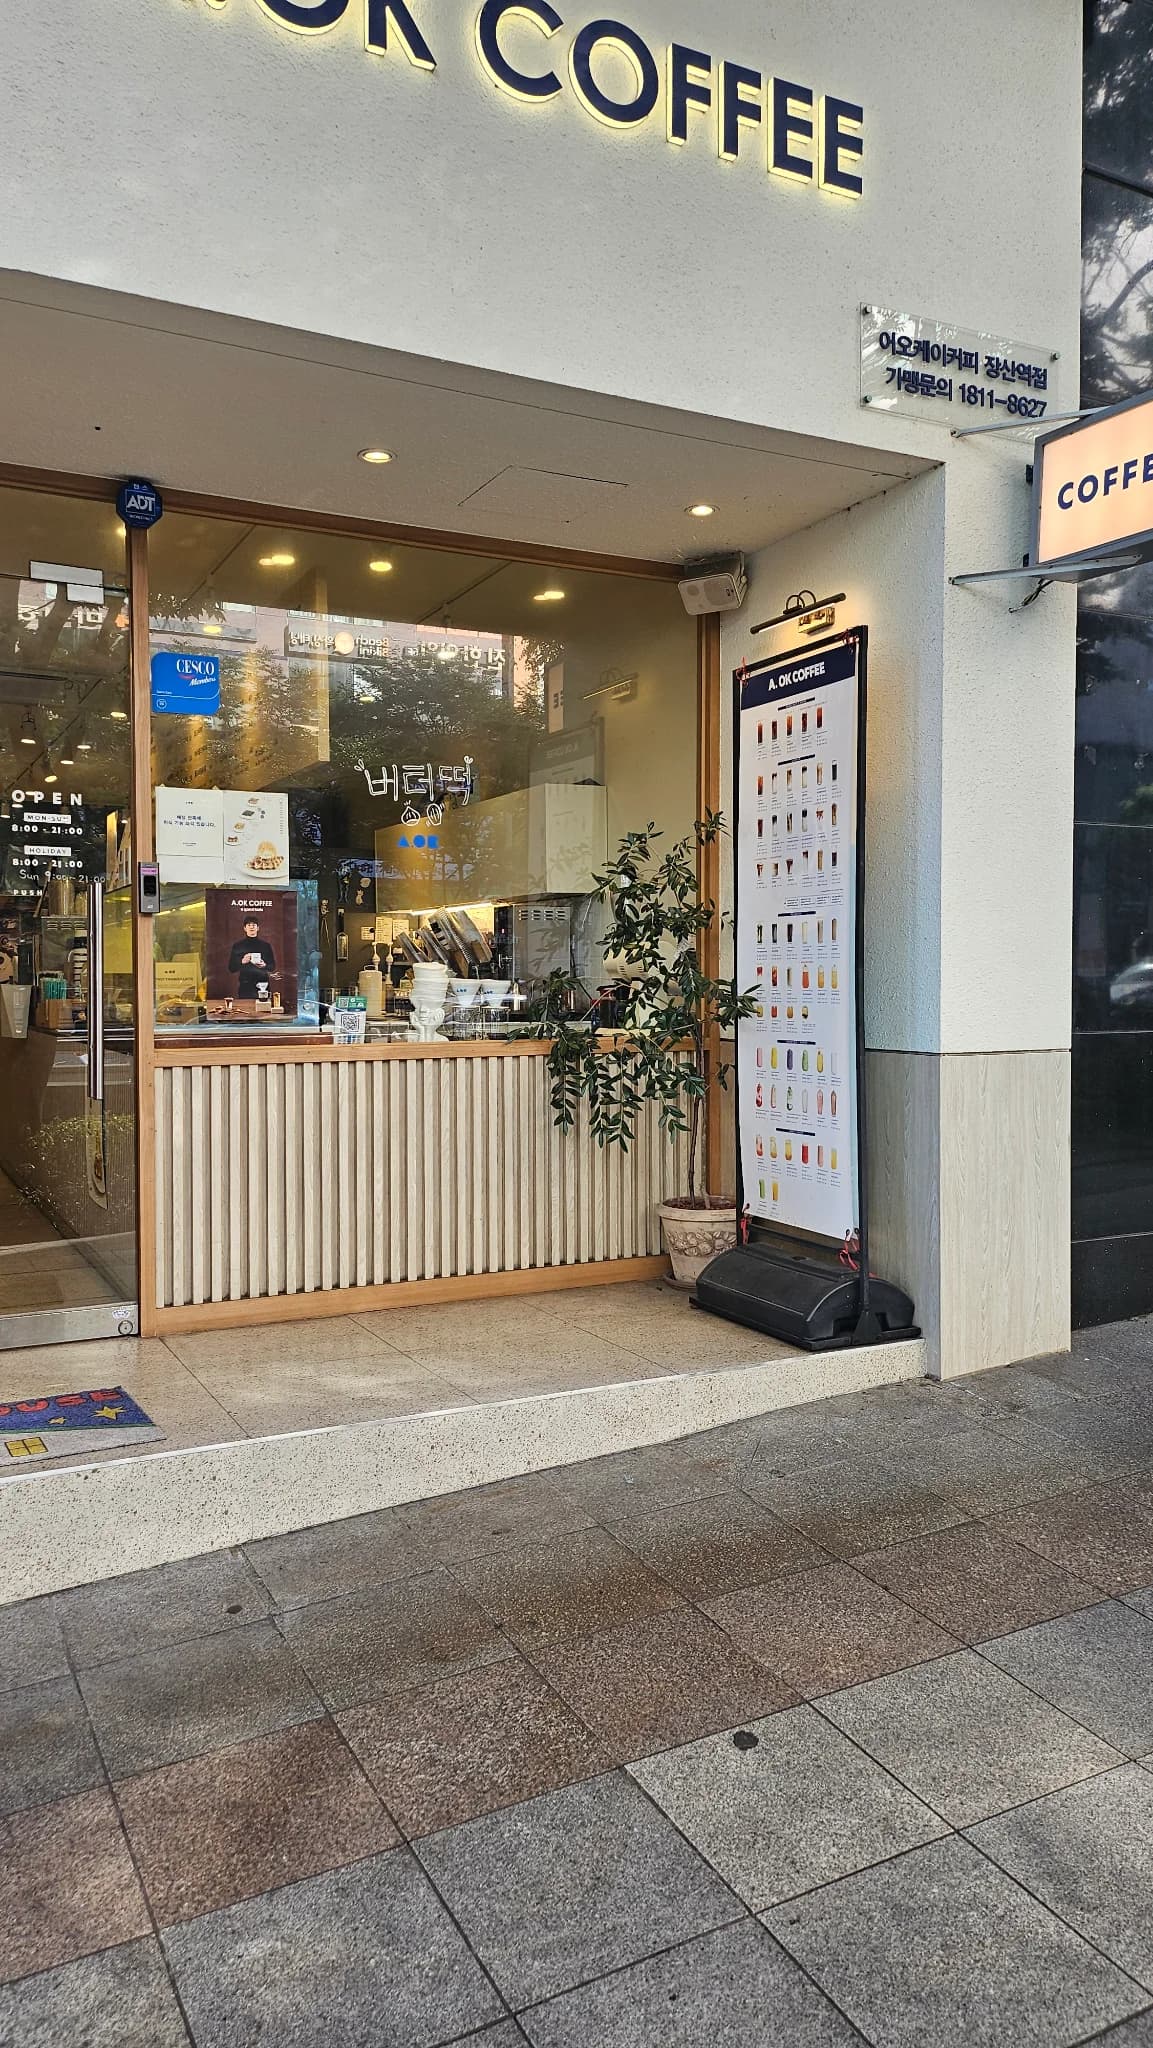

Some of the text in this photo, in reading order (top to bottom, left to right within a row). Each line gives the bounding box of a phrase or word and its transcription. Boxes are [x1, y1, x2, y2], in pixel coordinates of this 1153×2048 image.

[474, 0, 864, 199] COFFEE
[879, 332, 1048, 390] 어오케이커피 장산역점
[886, 367, 1048, 418] 가맹문의 1811-8627
[126, 494, 156, 512] ADT
[176, 658, 215, 676] CESCO
[792, 661, 826, 683] COFFEE
[363, 760, 473, 806] 버터떡
[11, 789, 83, 806] OPEN
[11, 824, 39, 833] 8:00
[51, 826, 83, 835] 21:00
[28, 846, 67, 855] HOLIDAY
[12, 858, 39, 867] 8:00
[51, 860, 83, 868] 21:00
[19, 869, 40, 881] Sun
